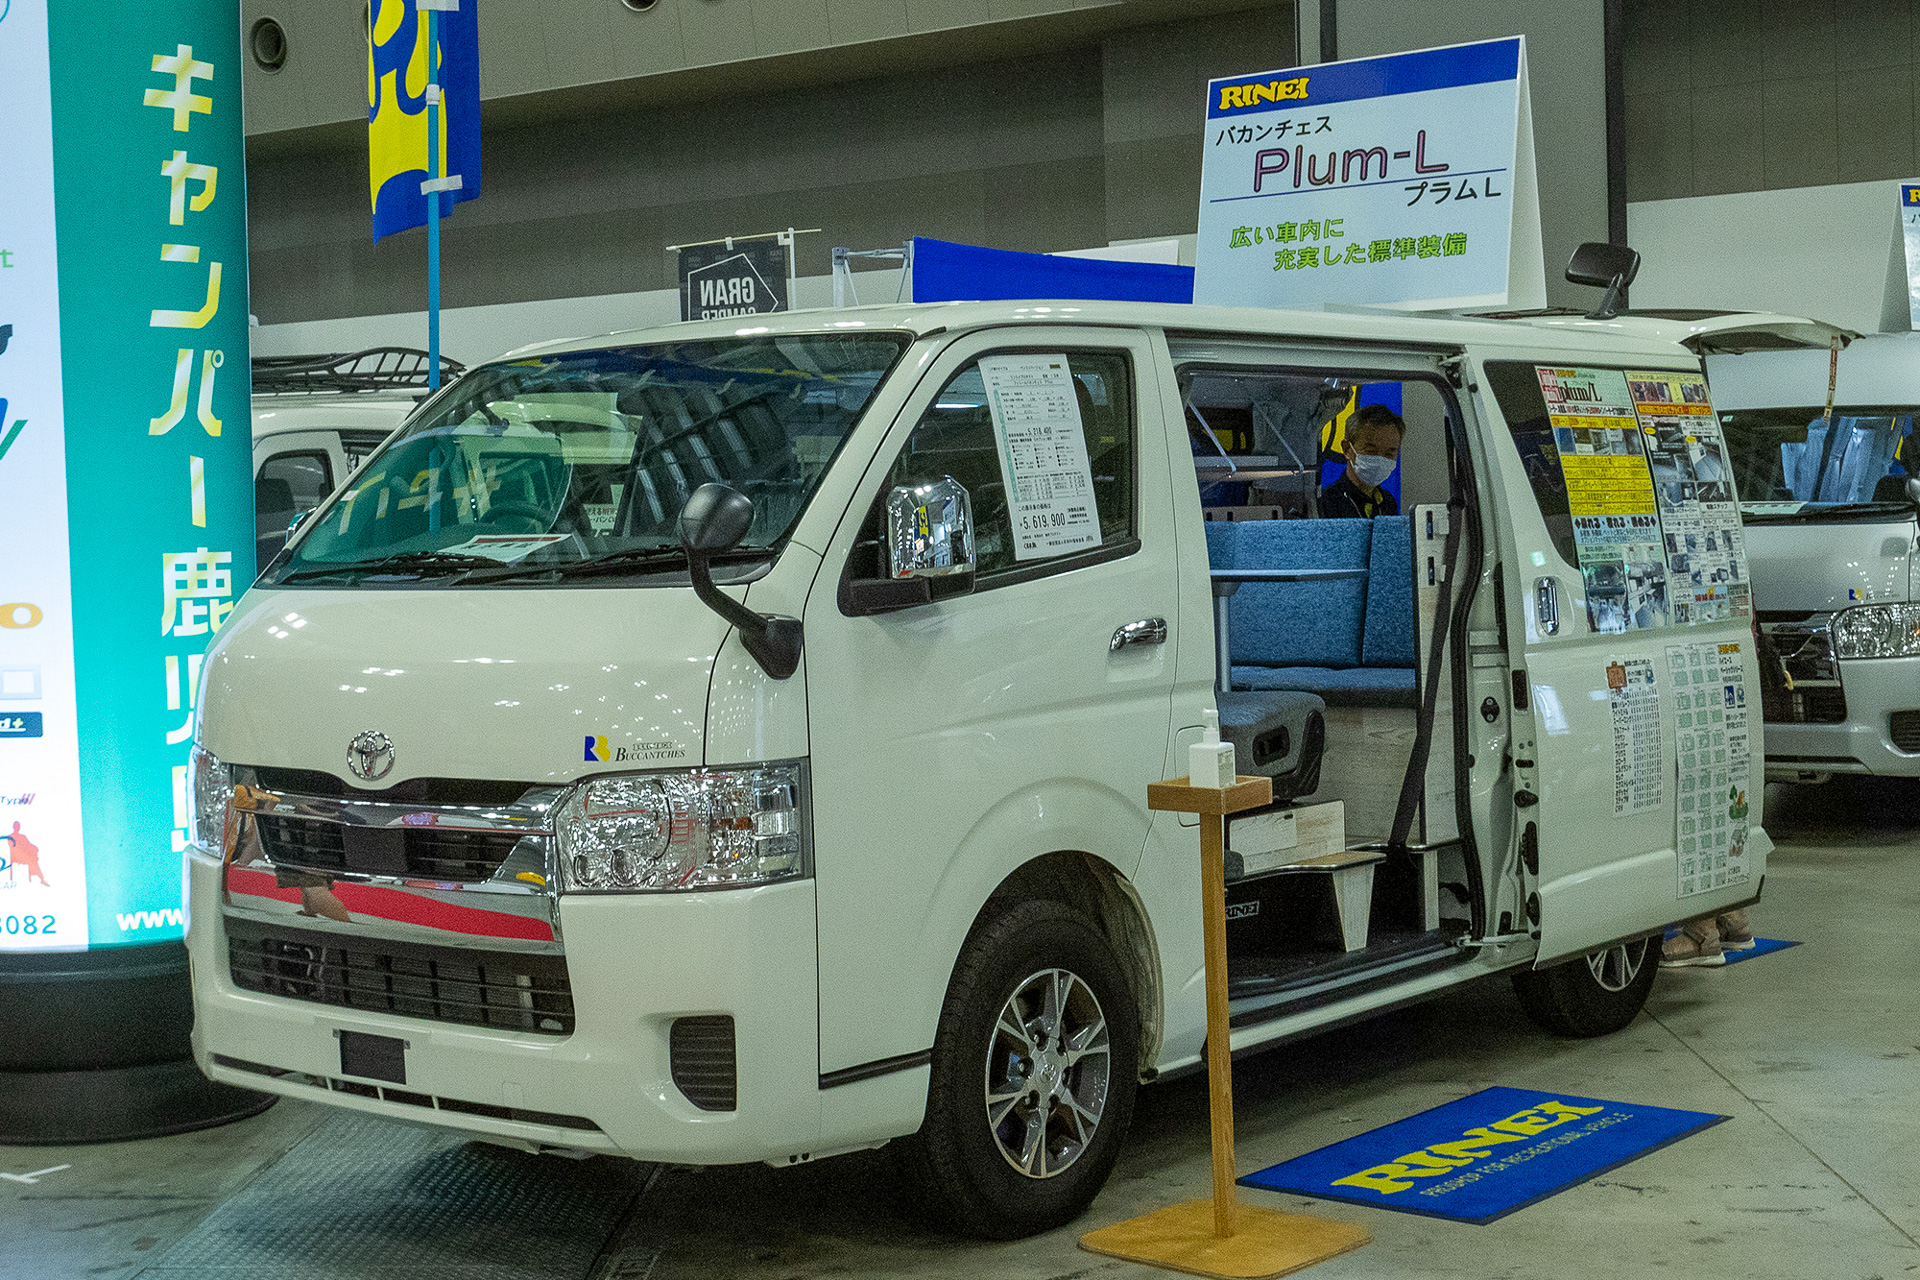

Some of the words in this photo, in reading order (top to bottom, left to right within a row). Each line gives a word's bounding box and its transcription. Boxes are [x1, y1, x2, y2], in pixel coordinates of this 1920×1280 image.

[1219, 77, 1310, 110] RINEI
[1216, 116, 1332, 146] バカンチェス
[1253, 130, 1449, 193] Plum-L
[1230, 219, 1344, 248] 広い車内に
[1274, 233, 1467, 271] 充実した標準装備
[143, 44, 234, 852] キャンパー鹿
[0, 915, 57, 935] 082
[1331, 1101, 1604, 1194] RINEI
